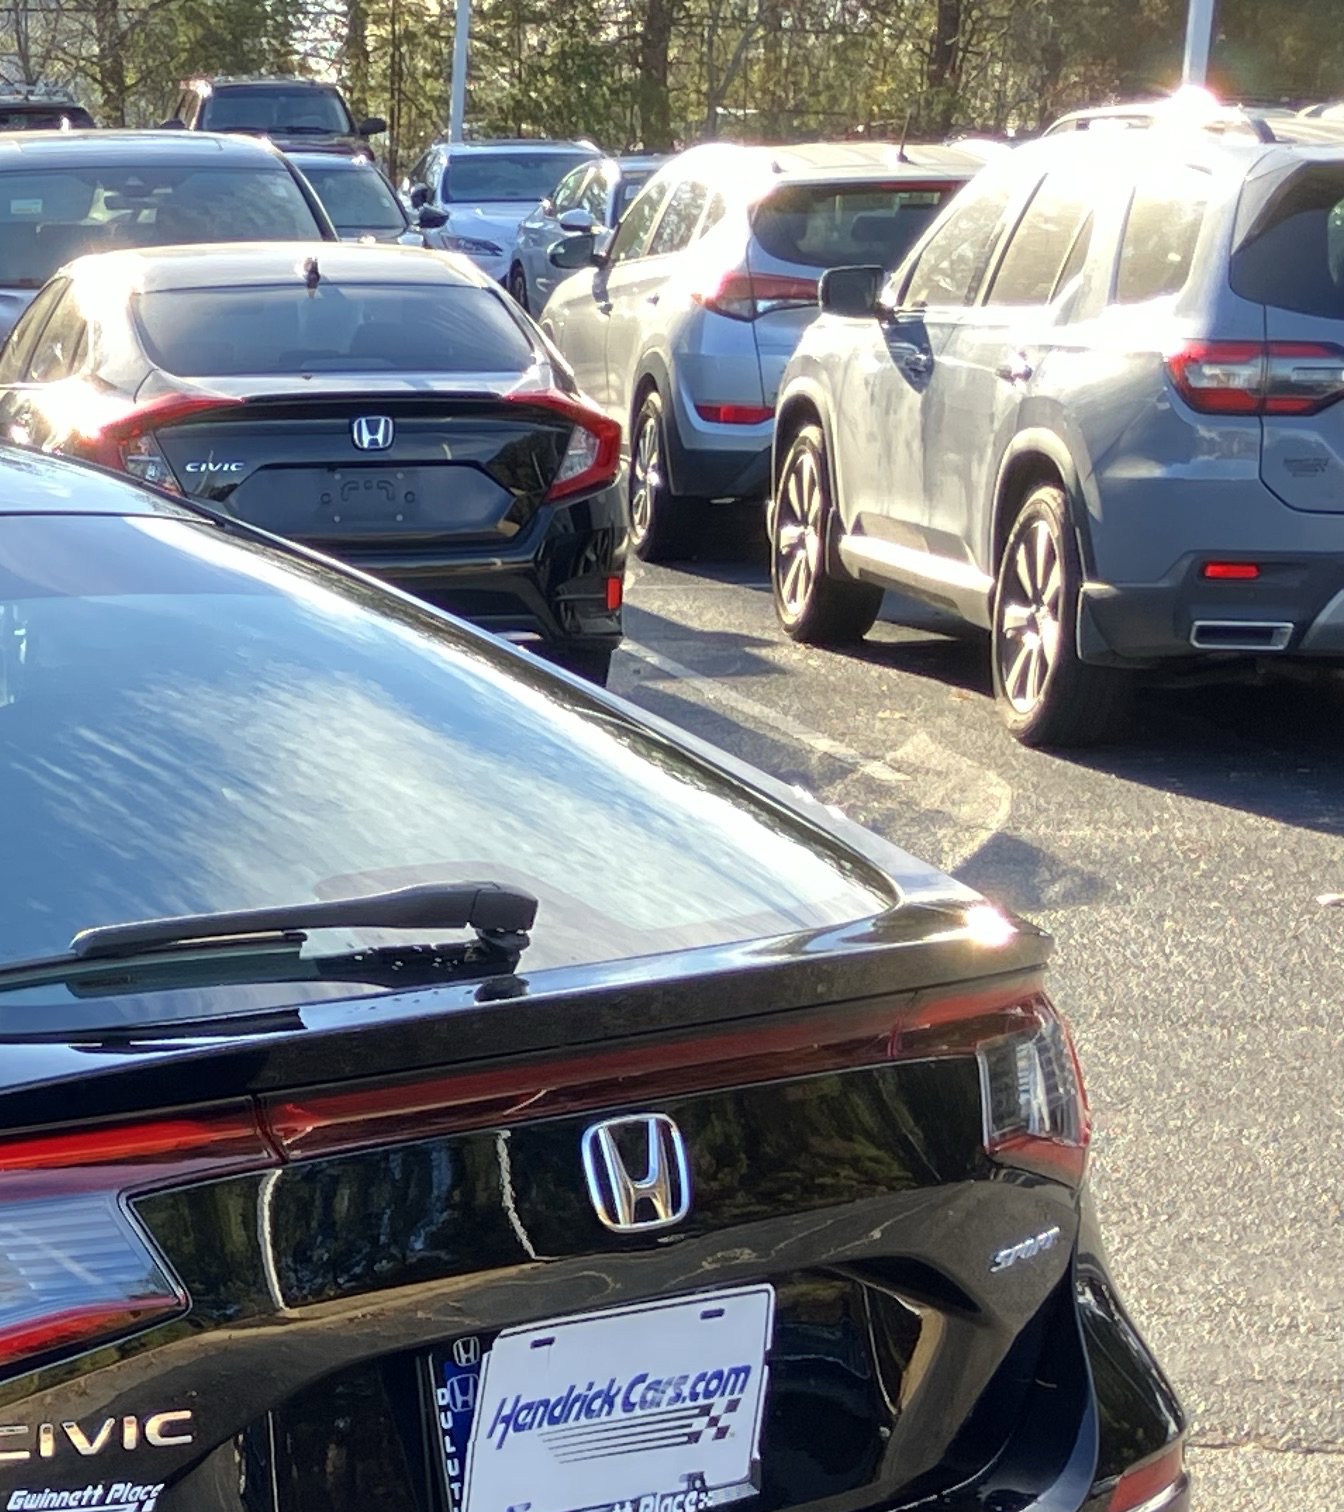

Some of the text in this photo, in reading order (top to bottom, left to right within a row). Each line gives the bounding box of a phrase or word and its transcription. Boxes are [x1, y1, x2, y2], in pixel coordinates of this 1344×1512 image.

[185, 462, 245, 473] CIVIC
[6, 1482, 165, 1511] Gwinnett Place
